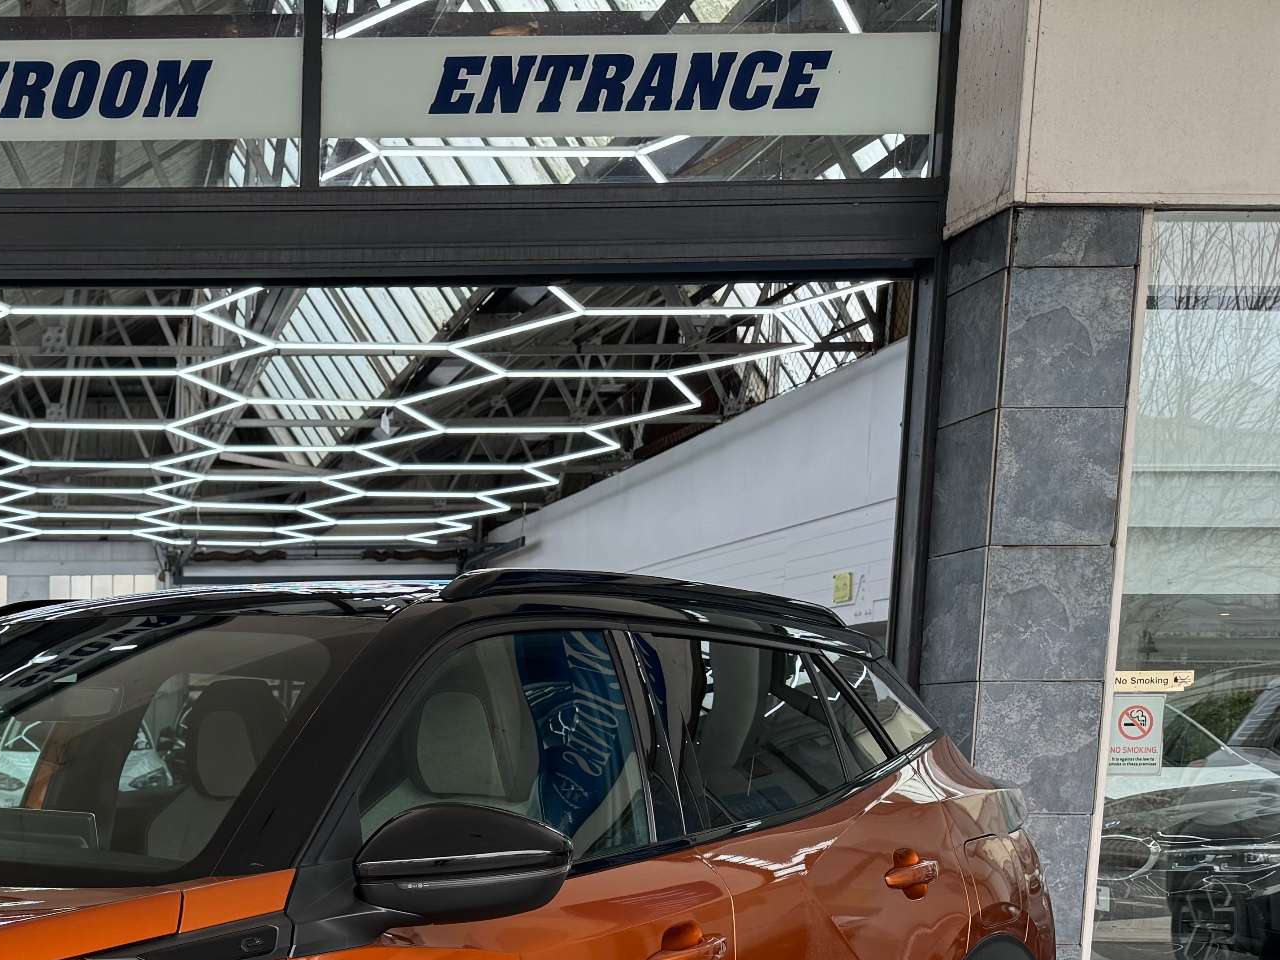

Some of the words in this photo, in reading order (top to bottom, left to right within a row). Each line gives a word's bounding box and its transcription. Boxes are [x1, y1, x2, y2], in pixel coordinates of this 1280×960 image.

[428, 49, 833, 114] ENTRANCE
[1114, 676, 1128, 685] No
[1130, 676, 1169, 686] Smoking
[1110, 746, 1121, 754] NO
